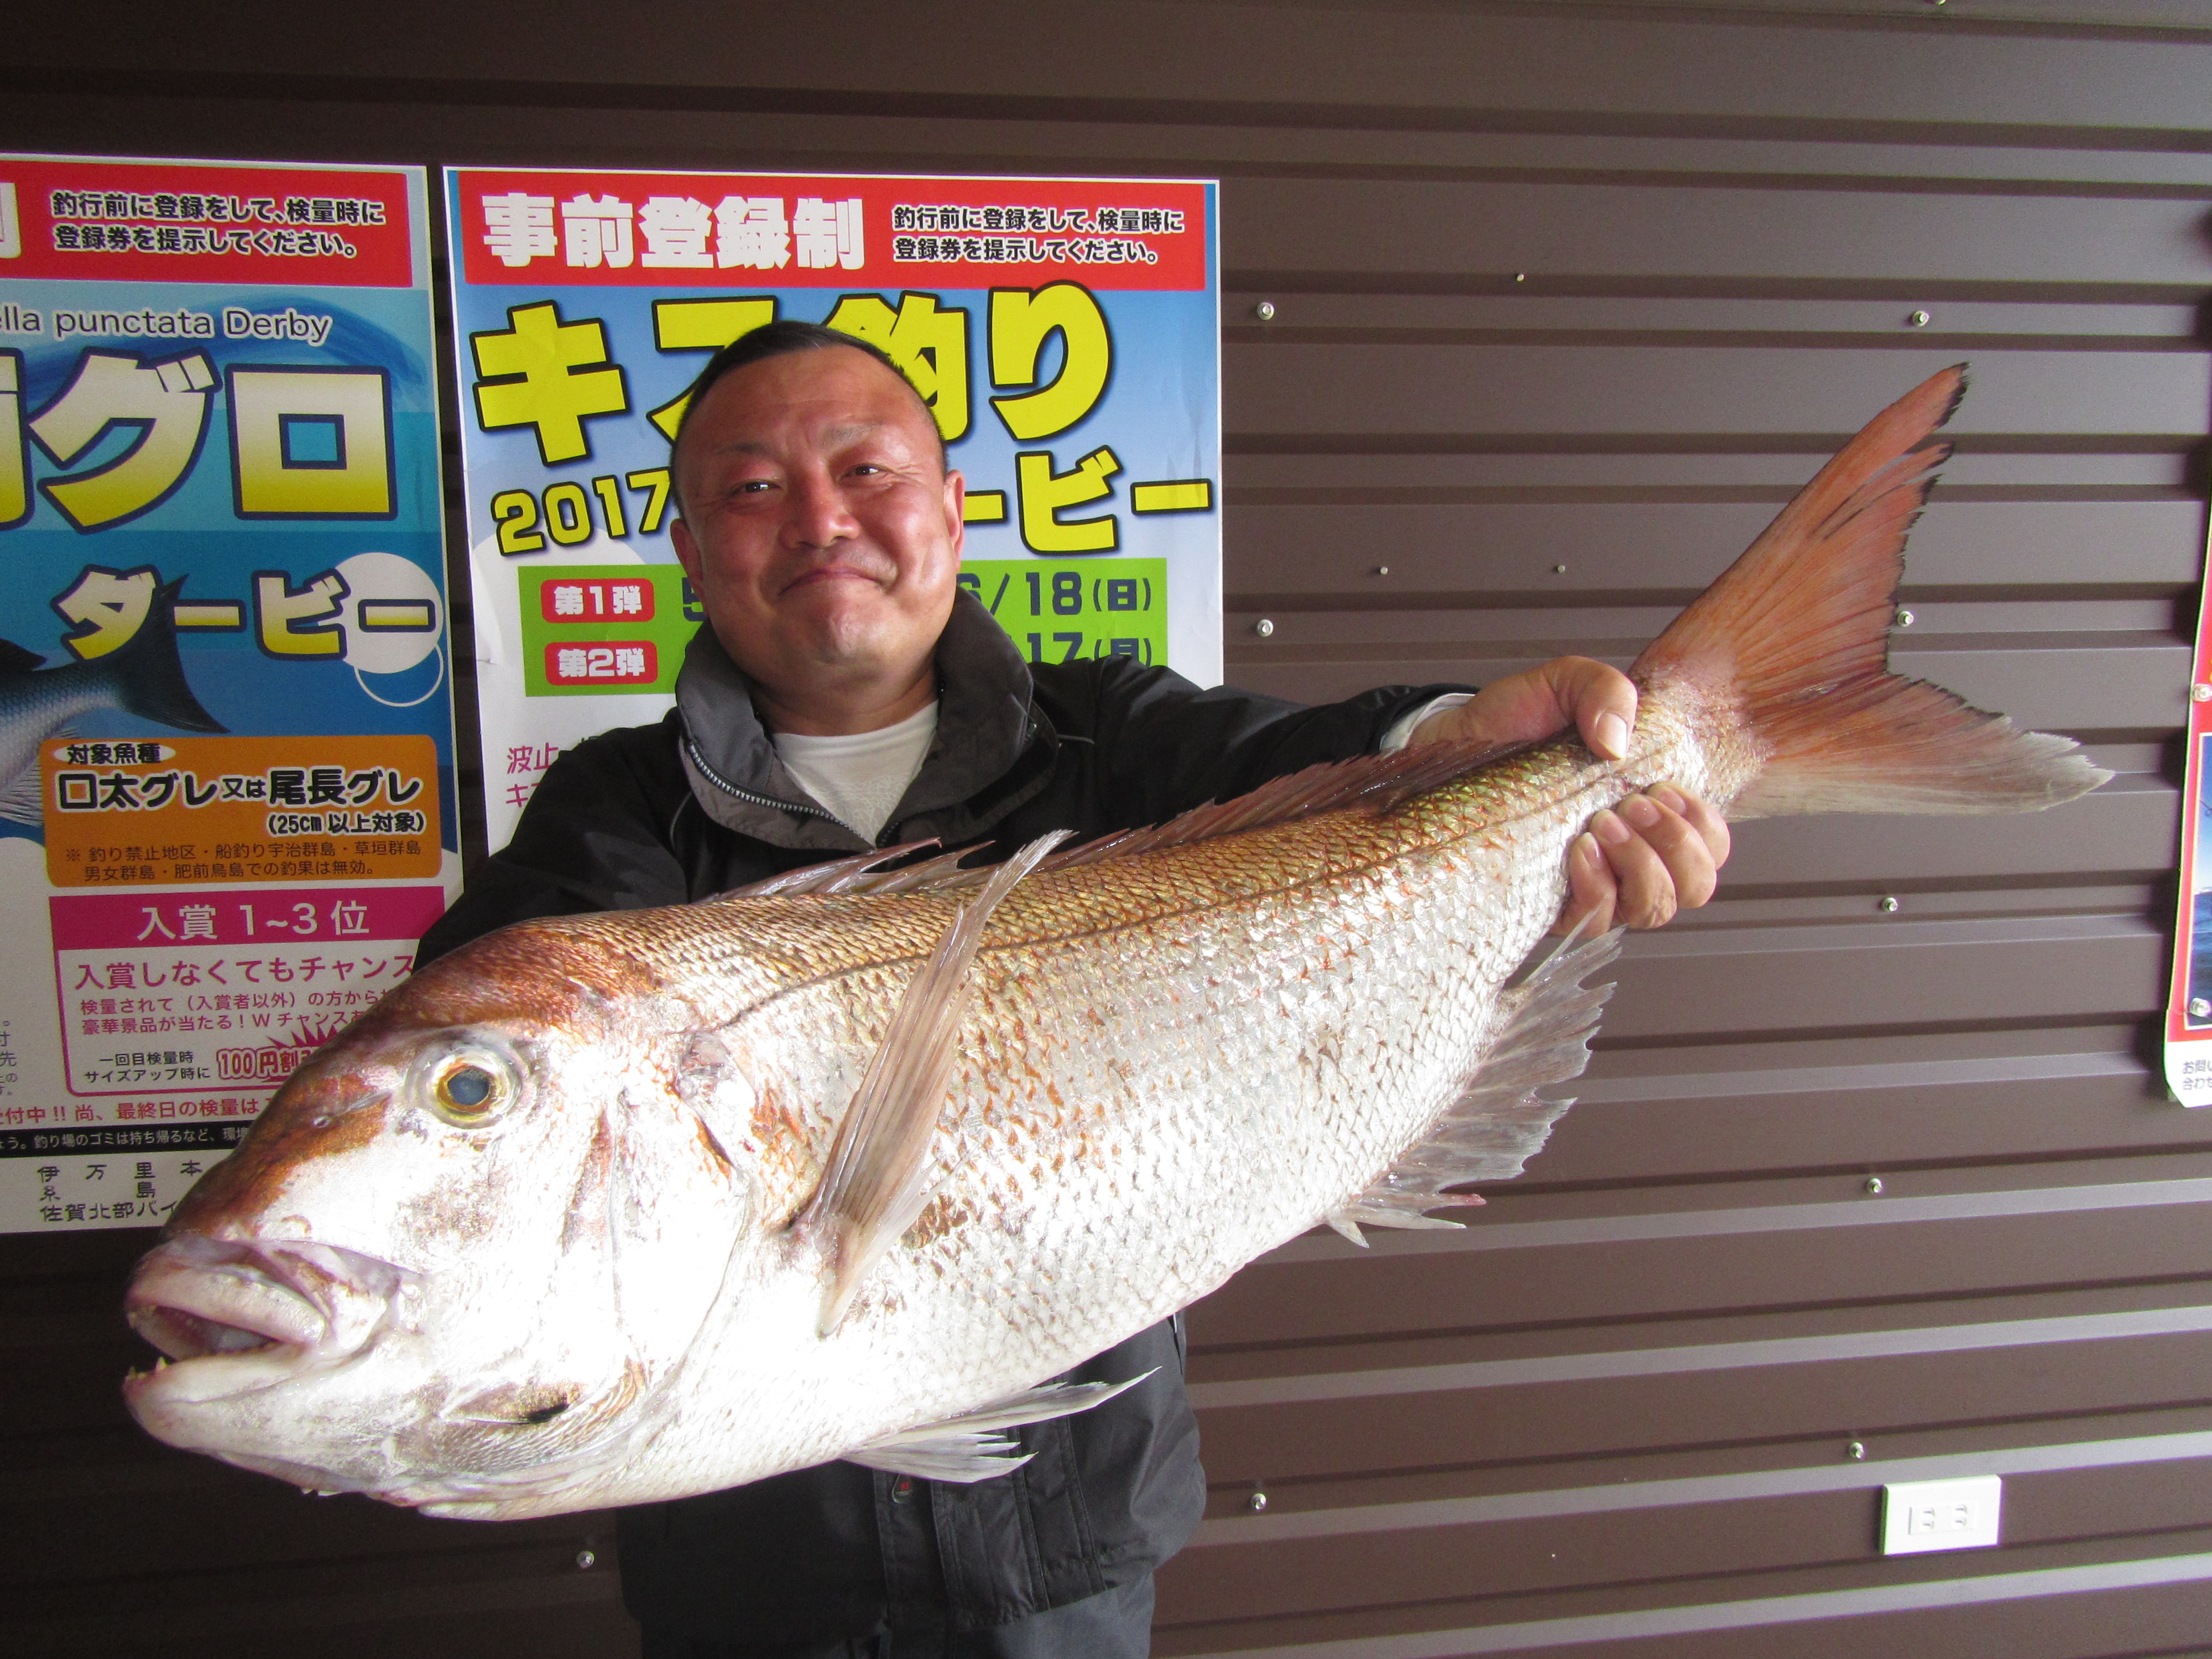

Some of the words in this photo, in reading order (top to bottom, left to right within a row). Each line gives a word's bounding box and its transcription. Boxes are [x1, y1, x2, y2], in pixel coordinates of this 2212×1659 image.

[51, 192, 385, 224] 釣行前に登録をして、検量時に
[894, 207, 1183, 232] 釣行前に登録をして、検量時に
[55, 225, 357, 257] 登録券を提示してください。
[482, 192, 864, 269] 事前登録制
[895, 239, 1157, 263] 登録券を提示してください。
[0, 306, 41, 331] lla
[56, 311, 212, 338] punctata
[226, 310, 330, 342] Derby
[0, 347, 398, 535] グロ
[490, 468, 671, 556] 2017
[51, 564, 436, 660] ダービー
[554, 586, 643, 614] 第1弾
[557, 648, 646, 678] 第2弾
[67, 743, 161, 764] 対象魚種
[75, 955, 414, 991] 入賞しなくてもチャンス
[99, 1051, 194, 1066] 一回目検量時
[85, 1067, 211, 1083] サイズアップ時に
